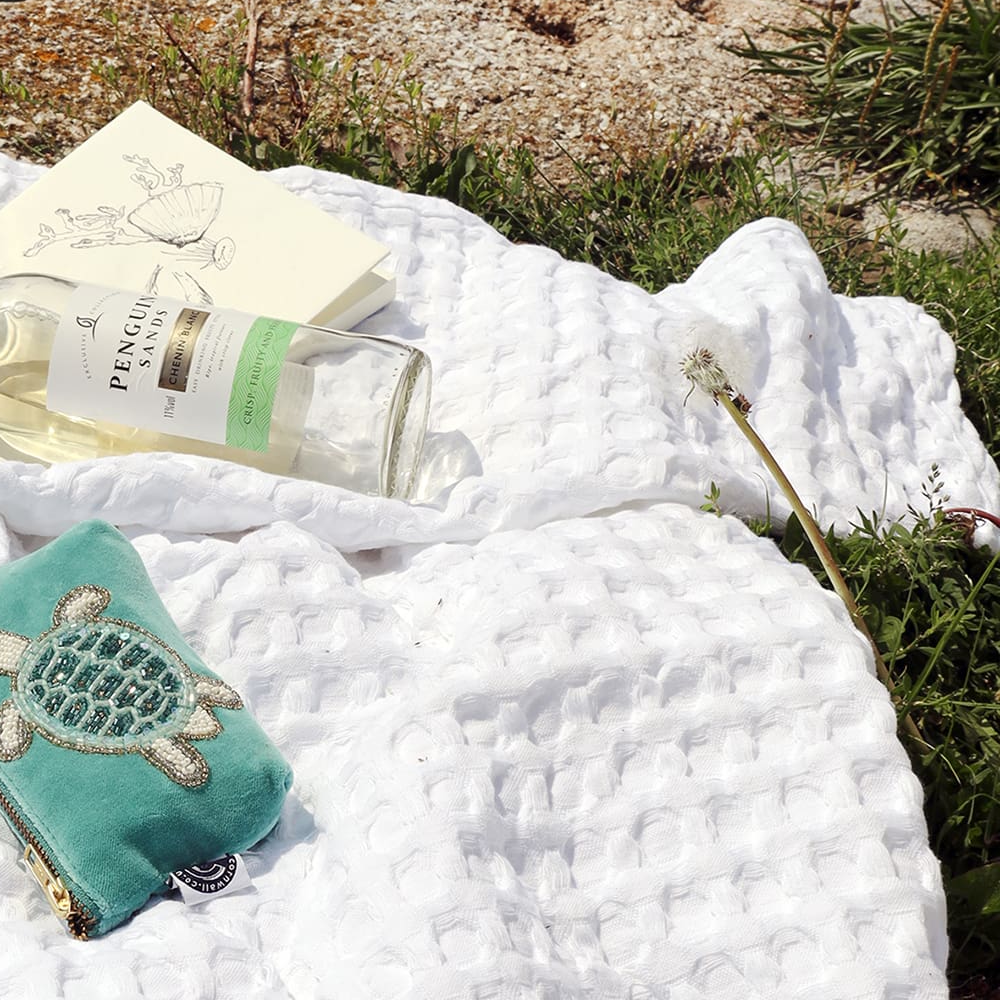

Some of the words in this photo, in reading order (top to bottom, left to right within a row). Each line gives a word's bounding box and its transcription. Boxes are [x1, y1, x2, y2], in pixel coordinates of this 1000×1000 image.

[109, 295, 157, 392] PENGUIN
[138, 309, 168, 369] SANDS
[168, 339, 187, 385] CHENIN
[181, 310, 200, 337] BLANC
[250, 350, 267, 386] FRUITY
[262, 331, 274, 349] AND
[175, 858, 236, 892] cornwall.co.u
